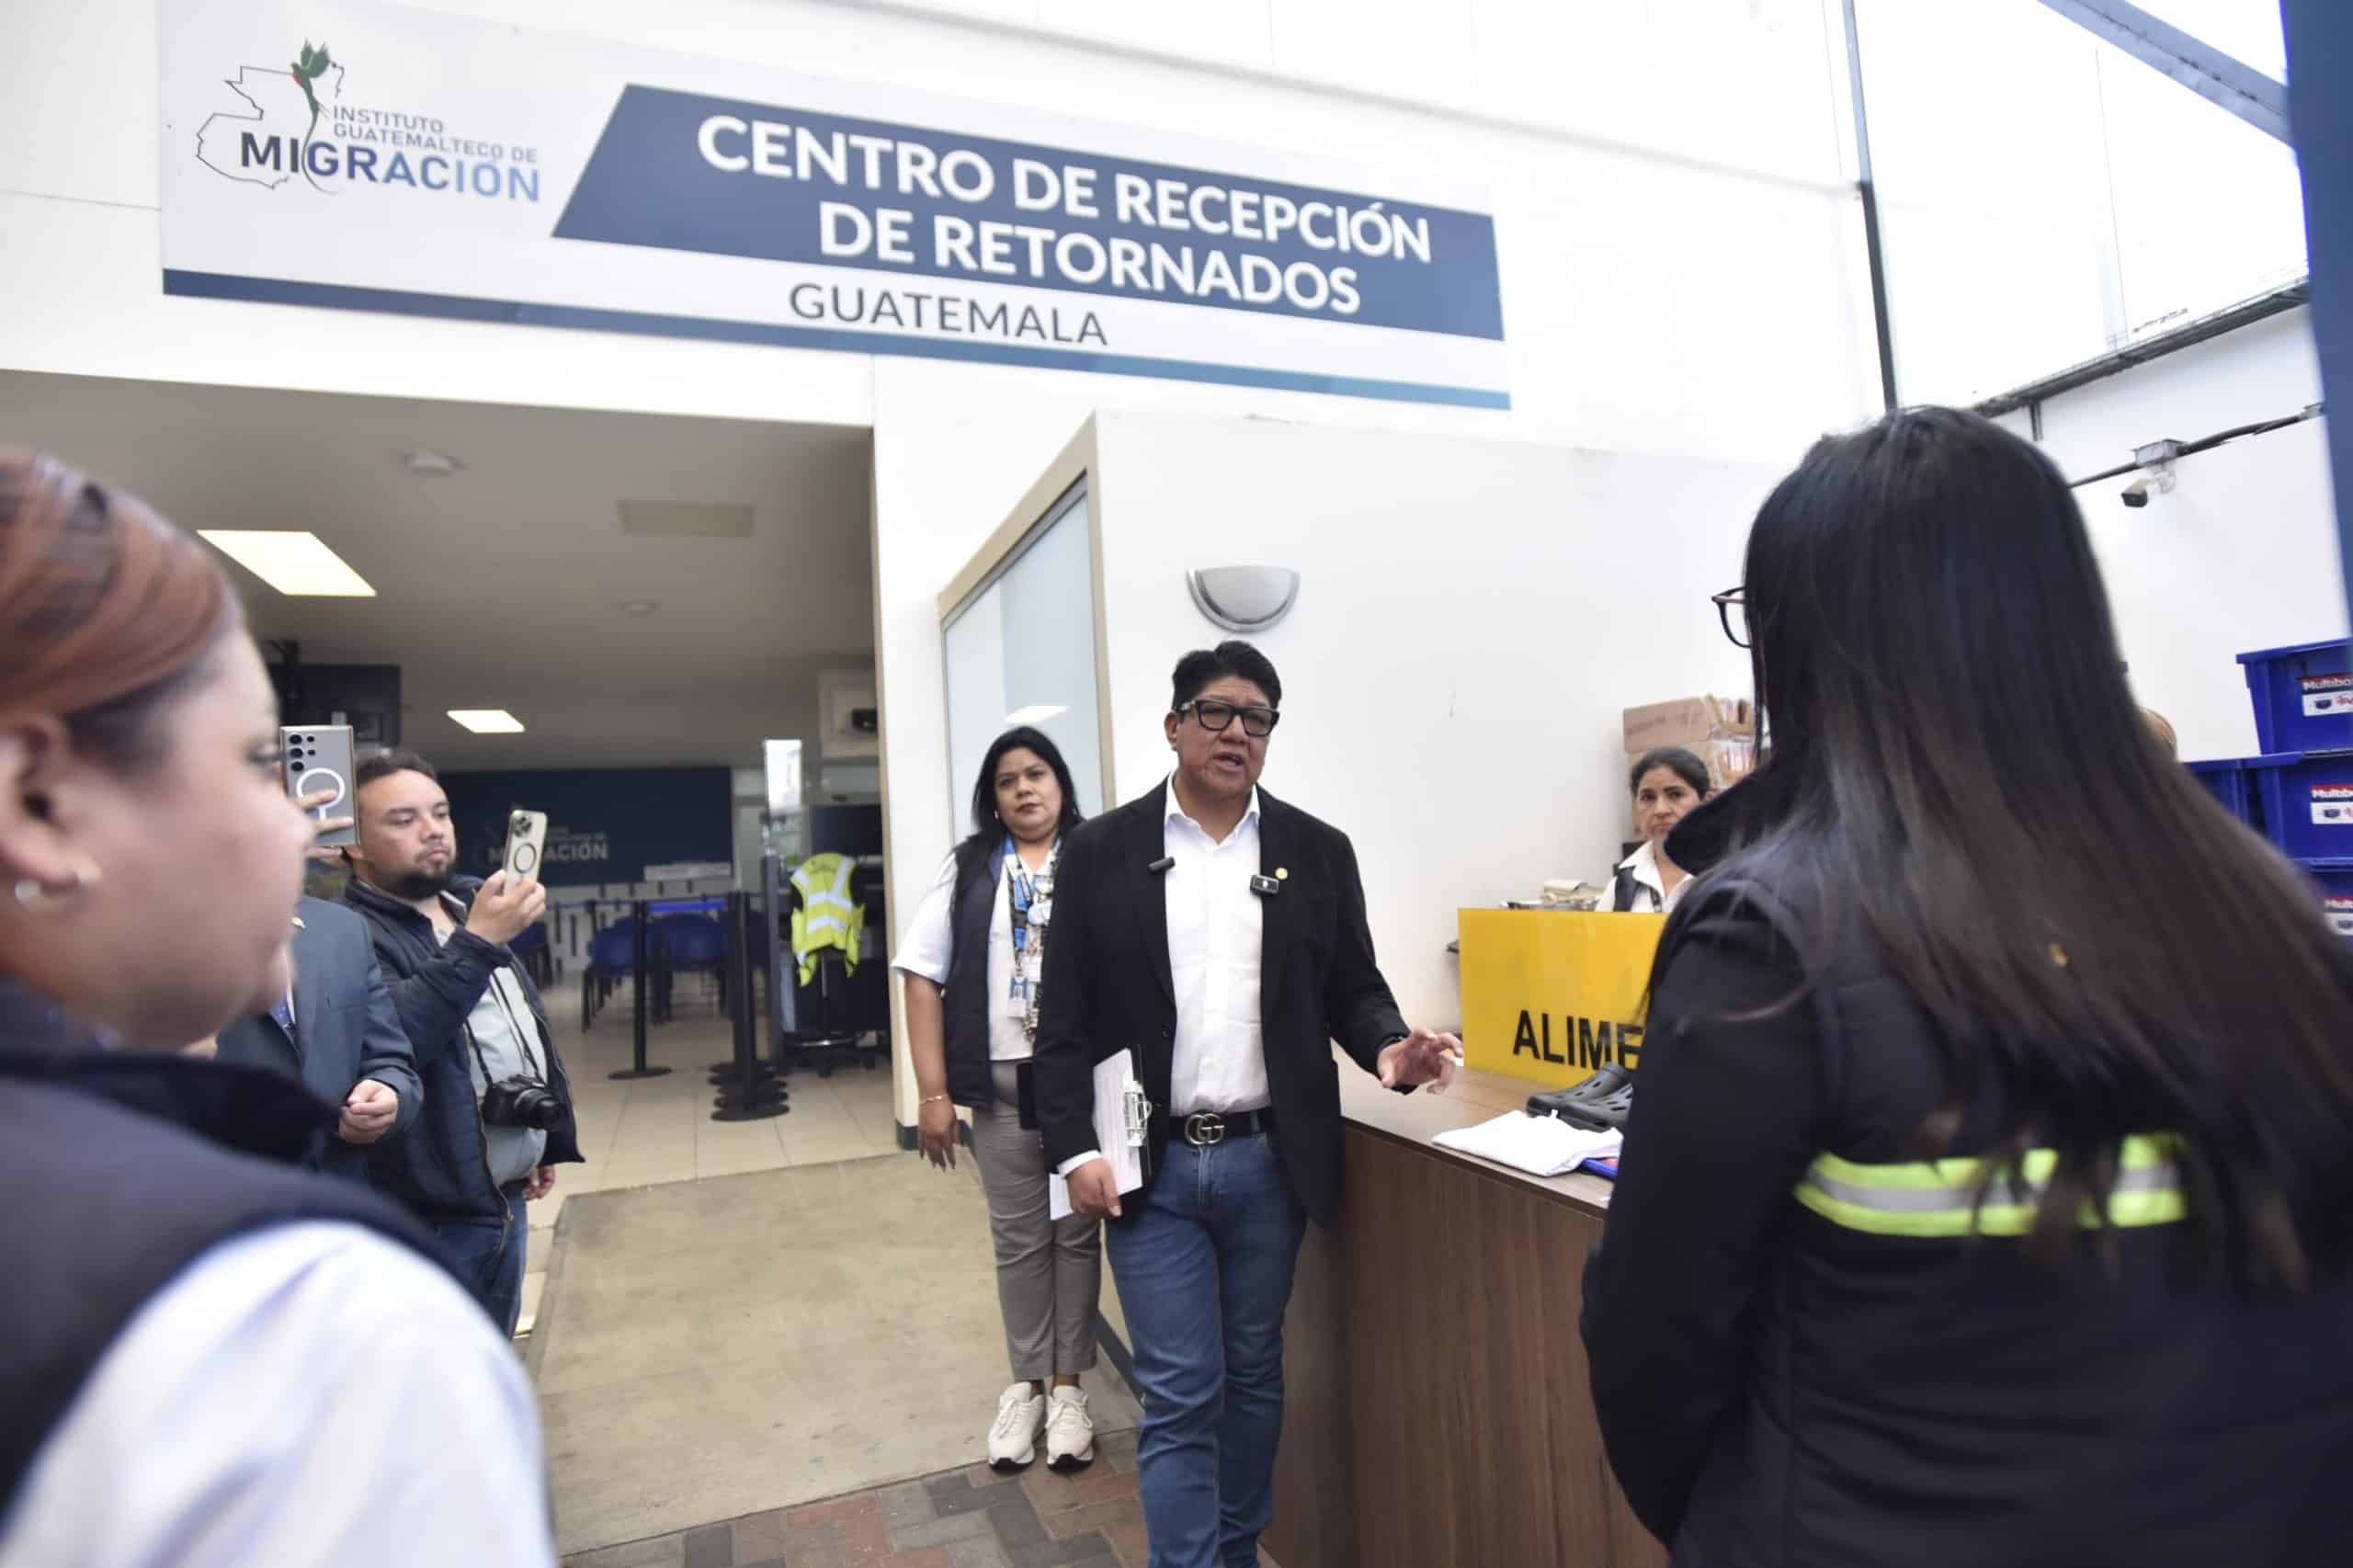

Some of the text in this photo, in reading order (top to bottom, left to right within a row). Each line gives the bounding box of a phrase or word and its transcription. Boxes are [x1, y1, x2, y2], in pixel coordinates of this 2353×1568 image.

[333, 104, 444, 133] INSTITUTO
[333, 122, 539, 163] GUATEMALTECO DE
[697, 114, 1432, 263] CENTRO DE RECEPCIÓN
[819, 199, 1362, 315] DE RETORNADOS
[788, 281, 1109, 347] GUATEMALA
